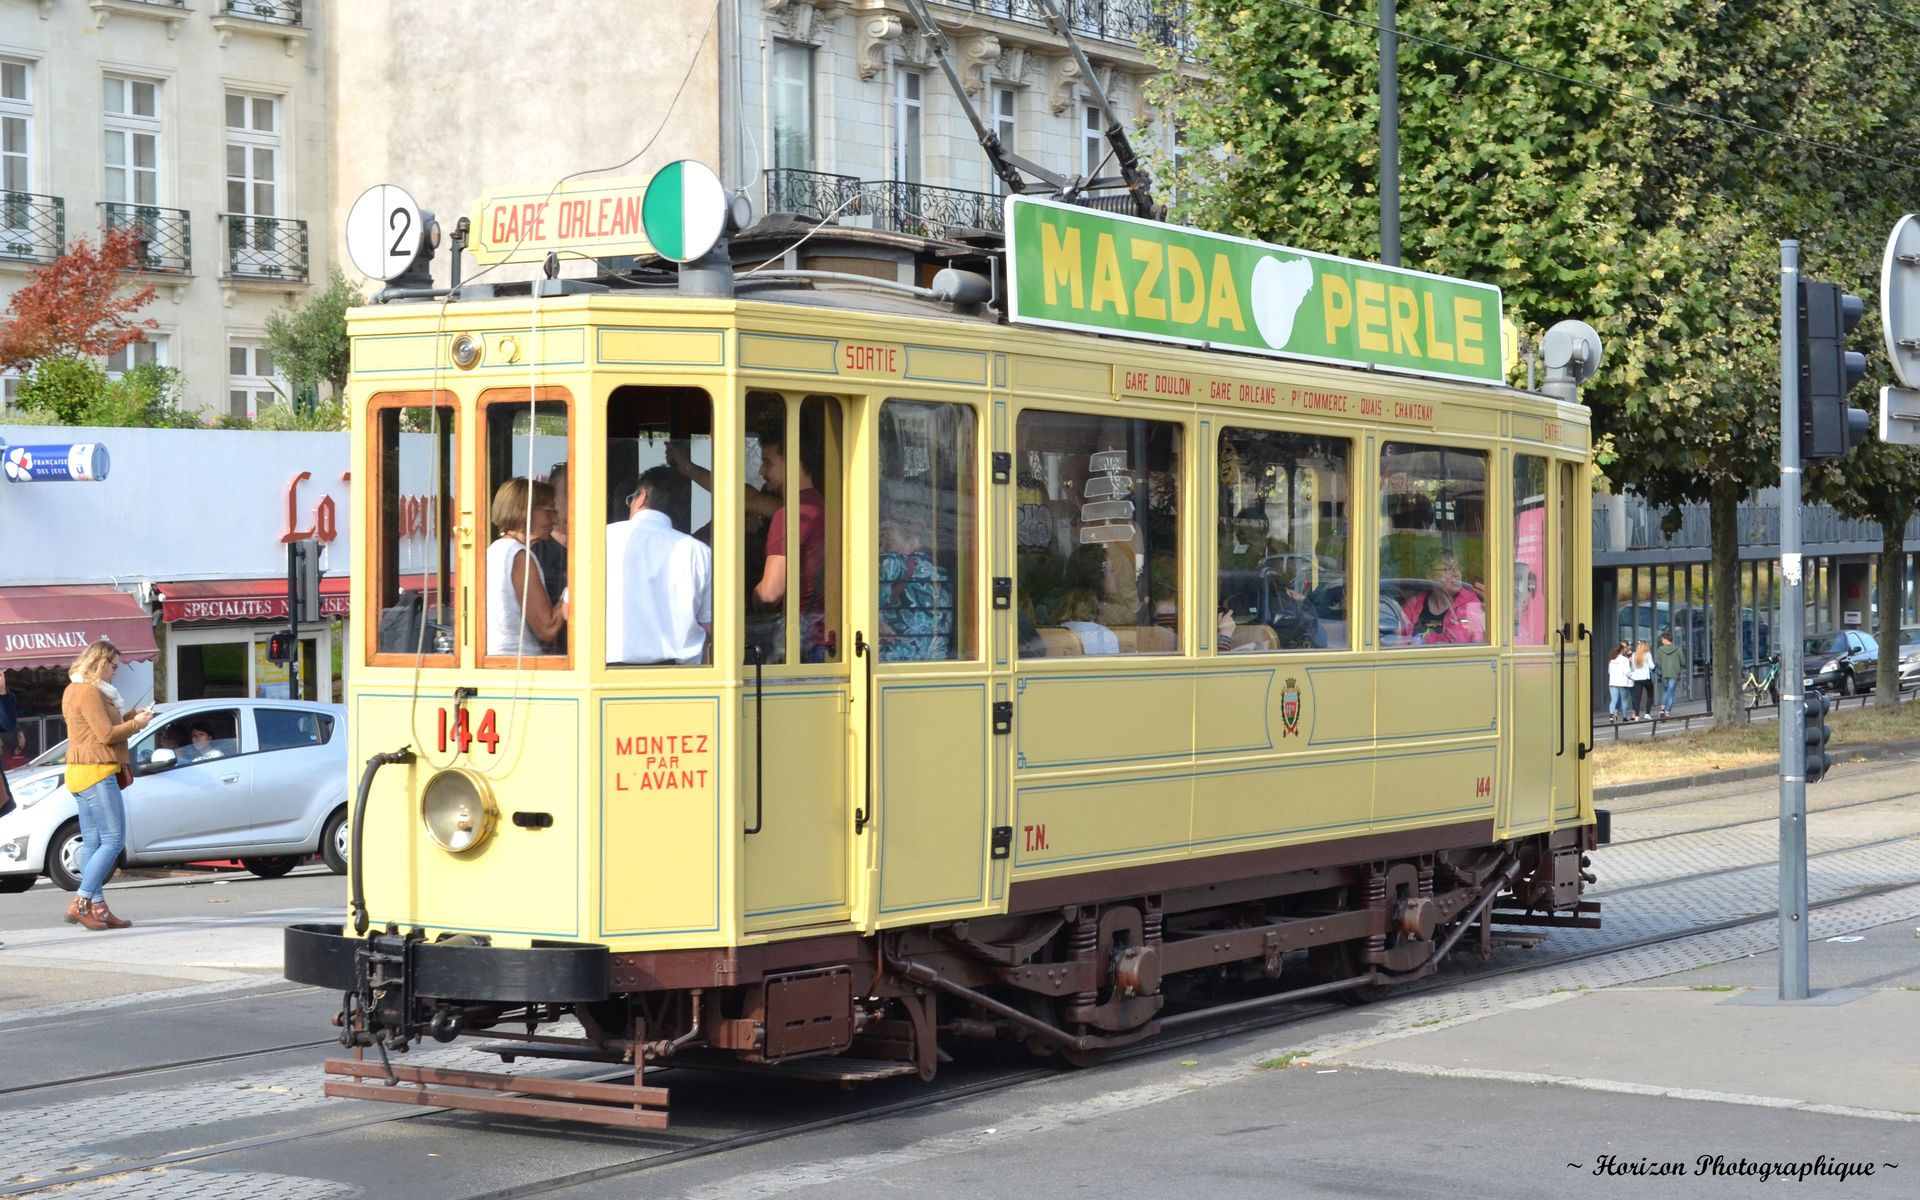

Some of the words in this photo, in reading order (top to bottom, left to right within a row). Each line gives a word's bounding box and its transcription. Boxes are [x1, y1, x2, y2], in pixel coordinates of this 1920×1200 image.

[389, 207, 411, 256] 2
[492, 203, 549, 244] GARE
[558, 196, 645, 239] ORLEAN
[1041, 222, 1246, 332] MAZDA
[1322, 274, 1485, 366] PERLE
[846, 345, 897, 372] SORTIE
[1125, 371, 1148, 391] GARE
[1155, 374, 1191, 395] DOULON
[1210, 381, 1231, 400] GARE
[1239, 384, 1275, 404] ORLEANS
[1303, 392, 1348, 412] COMMERCE
[1360, 398, 1382, 416] QUAIS
[1395, 401, 1434, 421] CHANTENAY
[280, 471, 338, 543] La
[184, 600, 272, 617] SPECIALITES
[5, 631, 88, 651] JOURNAUX
[438, 707, 500, 754] 144
[616, 735, 708, 755] MONTEZ
[647, 756, 679, 769] PAR
[1476, 776, 1490, 797] 144
[1024, 824, 1049, 852] T.N.
